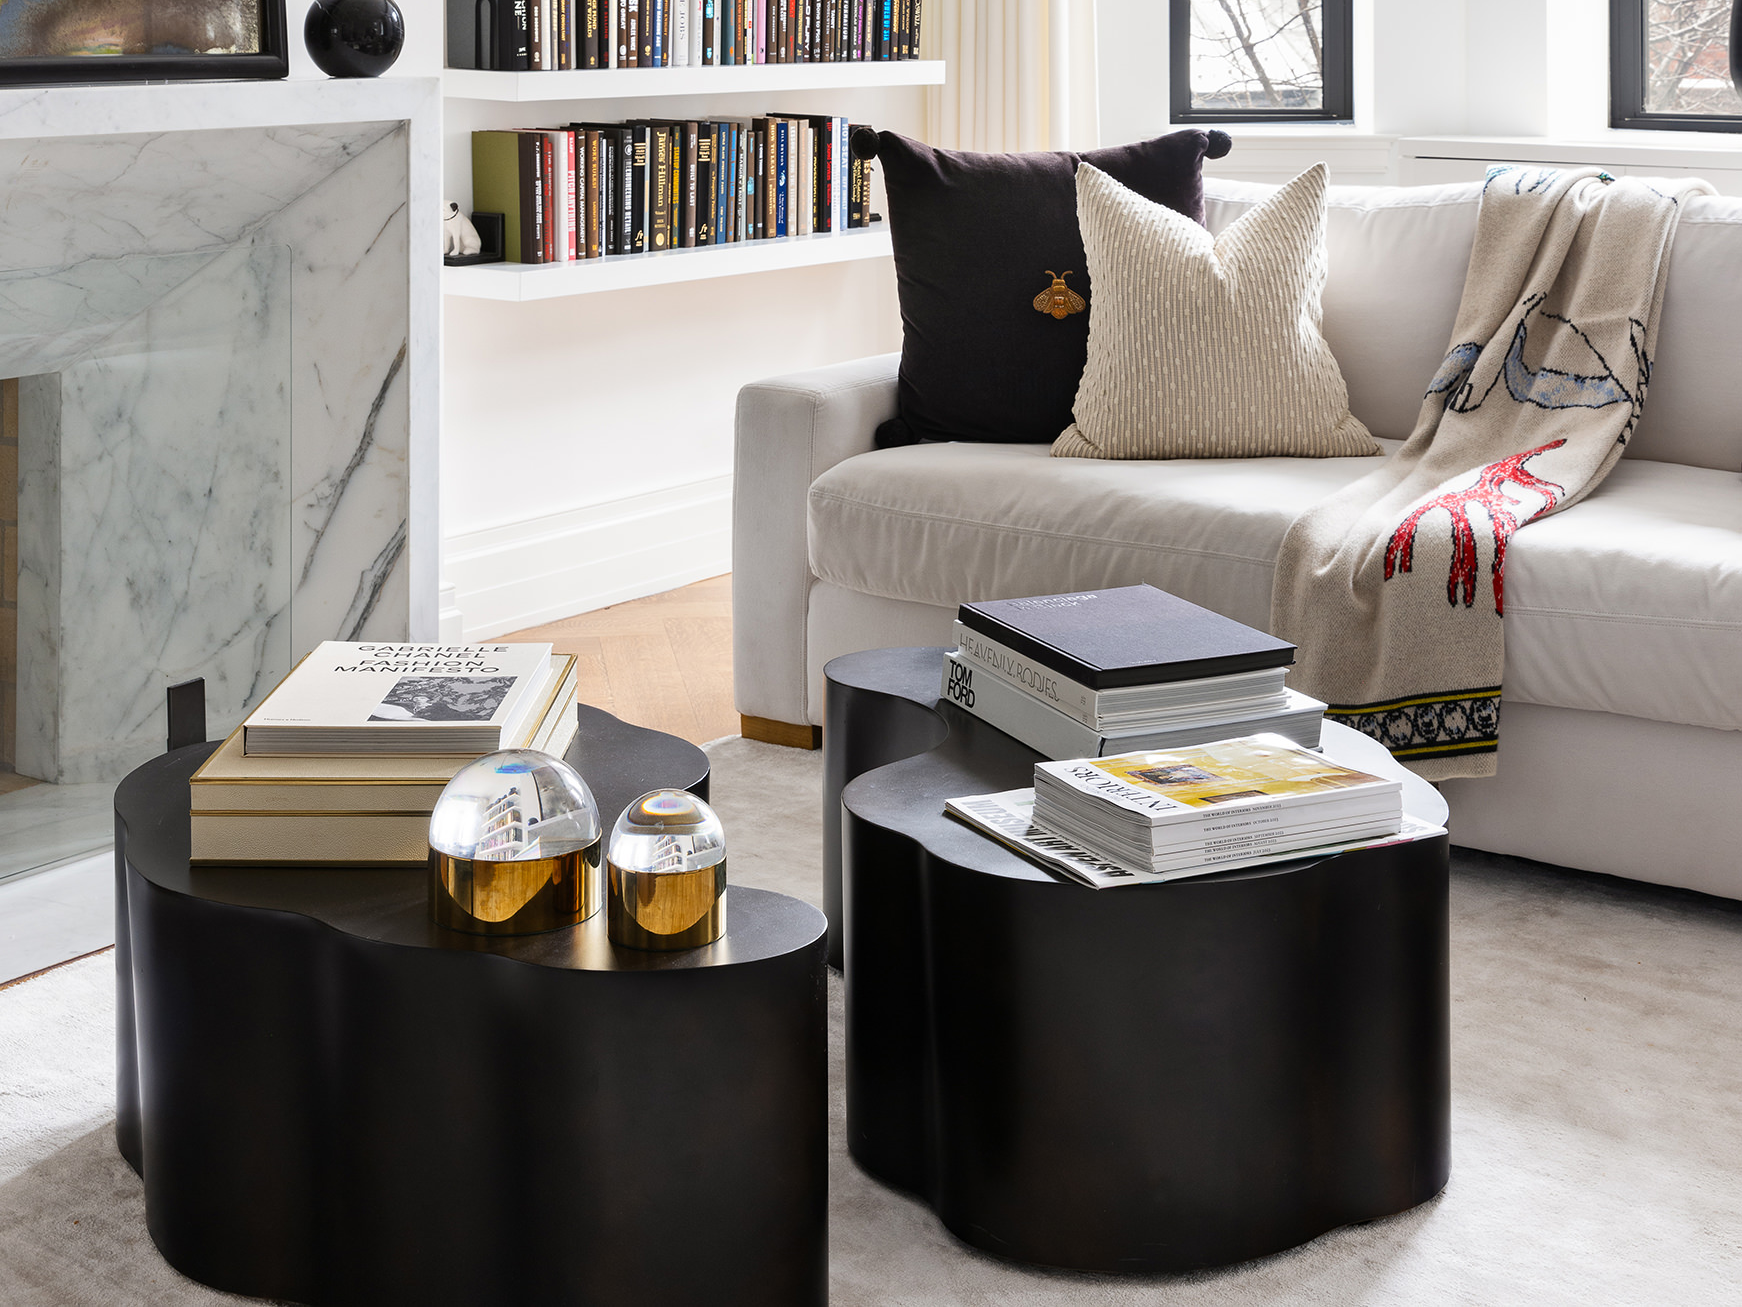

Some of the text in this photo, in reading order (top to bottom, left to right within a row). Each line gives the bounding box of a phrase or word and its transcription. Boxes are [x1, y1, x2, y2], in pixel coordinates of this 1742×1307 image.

[815, 20, 821, 28] to
[883, 20, 891, 28] OF
[883, 29, 891, 42] SIX
[770, 143, 776, 154] TO
[672, 146, 680, 170] STARTUP
[656, 132, 666, 208] James Hillman
[690, 182, 696, 191] TO
[568, 170, 576, 232] PITCH ANYTHING
[358, 645, 510, 653] GABRIELLE
[374, 651, 486, 659] CHANEL
[334, 665, 500, 673] MANIFESTO
[950, 659, 973, 688] TOM
[1016, 663, 1060, 702] BODIES
[947, 678, 975, 709] FORD
[1064, 766, 1178, 811] INTERIORS
[961, 799, 1048, 837] MUSEUM
